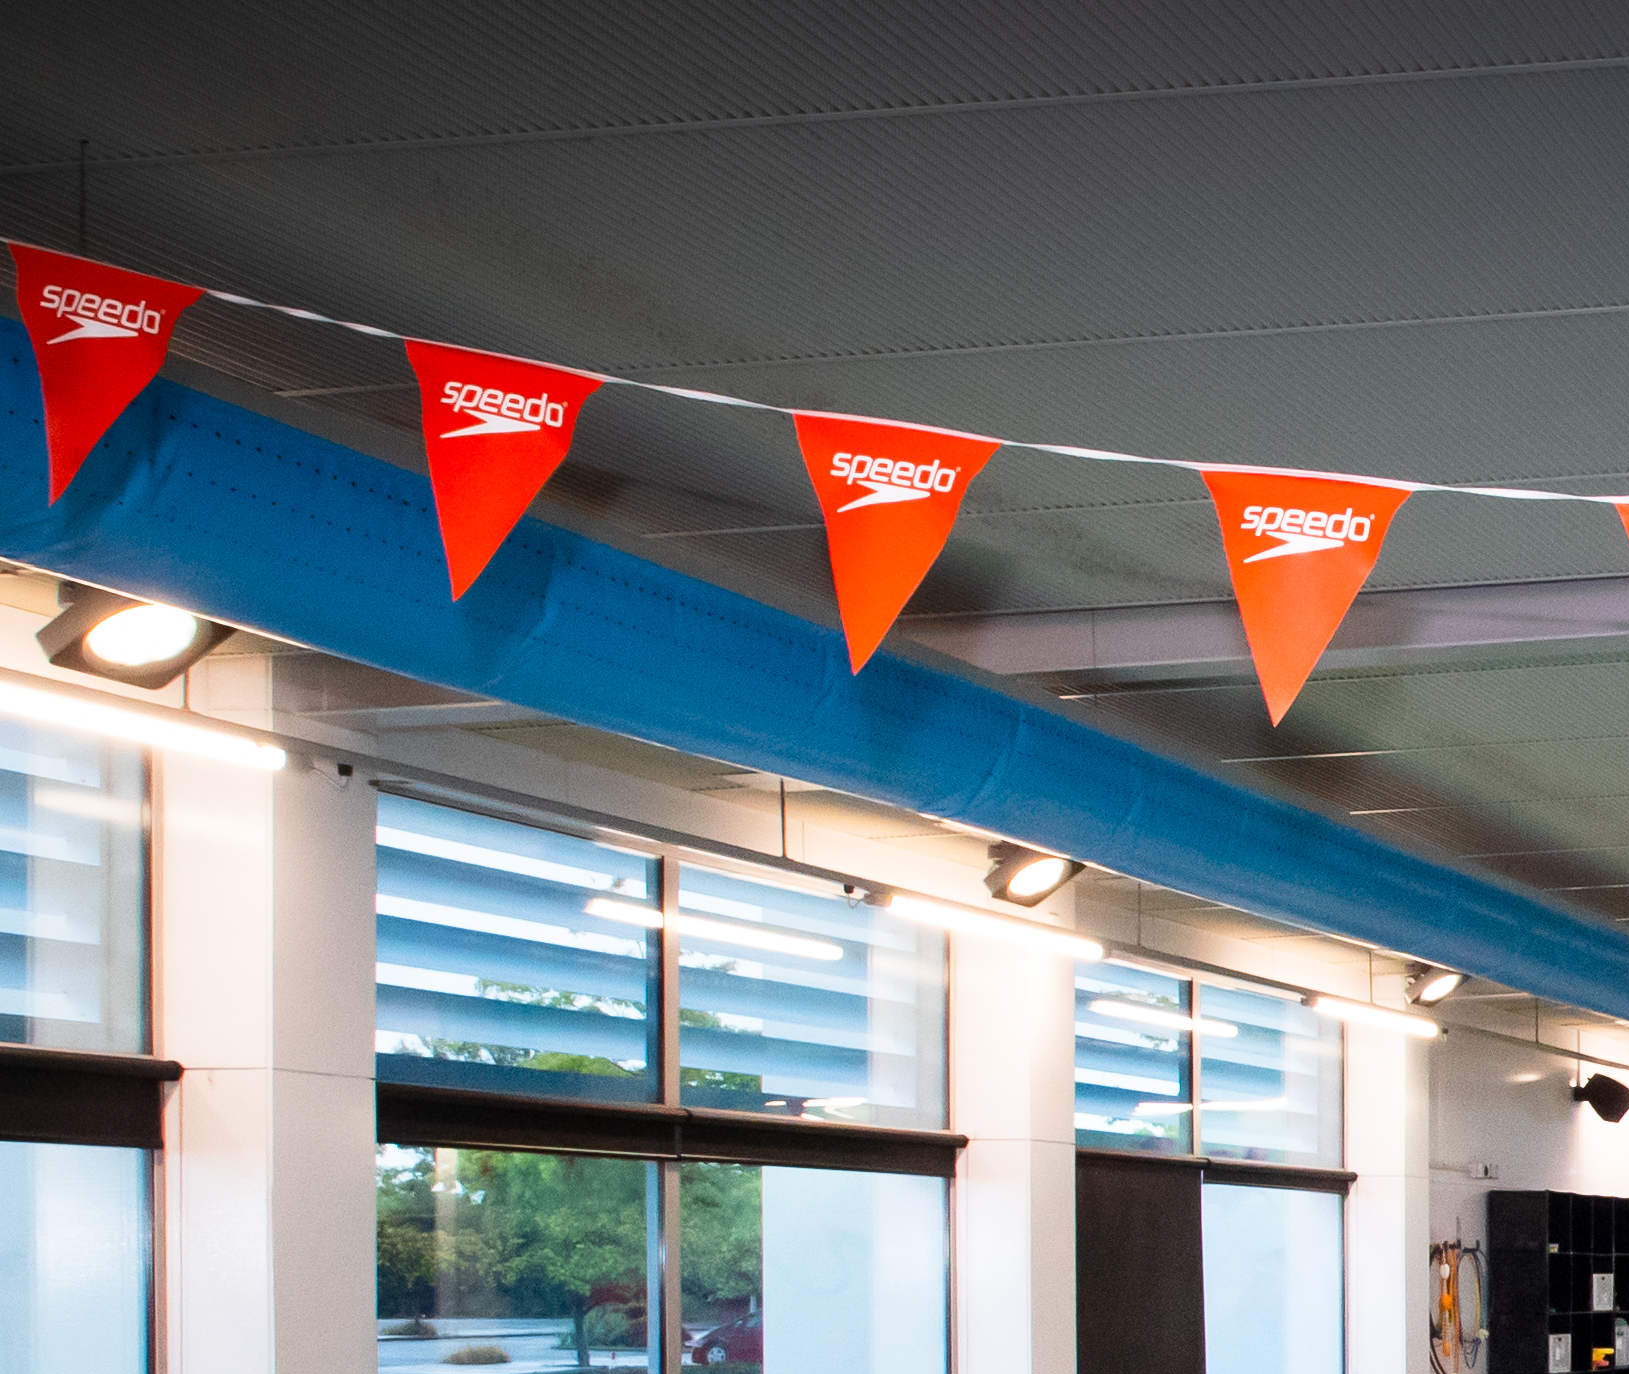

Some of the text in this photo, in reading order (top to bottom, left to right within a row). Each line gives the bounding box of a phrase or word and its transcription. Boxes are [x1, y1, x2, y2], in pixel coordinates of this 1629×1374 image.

[40, 285, 161, 335] speedo
[441, 381, 564, 427] speedo
[830, 453, 956, 492] speedo
[1241, 504, 1370, 541] speedo
